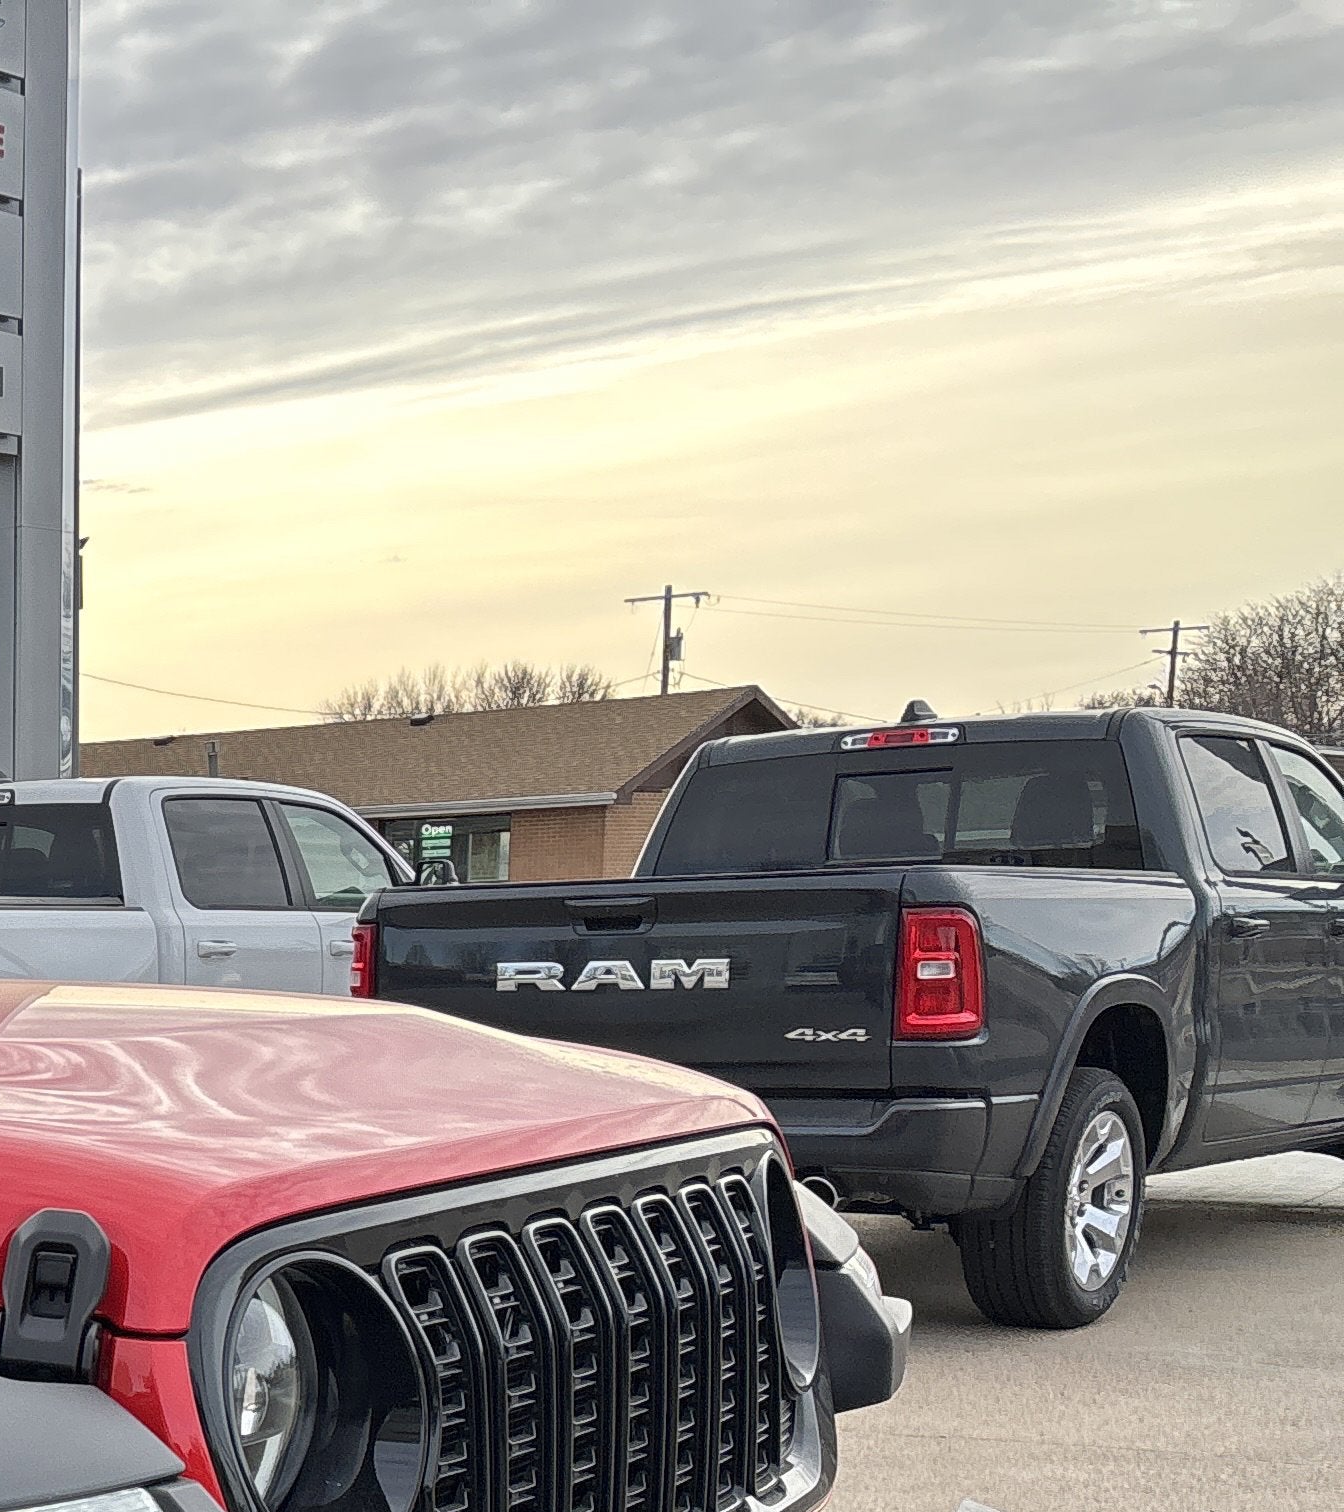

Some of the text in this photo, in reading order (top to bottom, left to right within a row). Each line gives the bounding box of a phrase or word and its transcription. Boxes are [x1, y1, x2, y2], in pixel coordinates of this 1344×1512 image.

[421, 824, 452, 837] Open
[496, 958, 731, 992] RAM
[784, 1027, 872, 1043] 4x4
